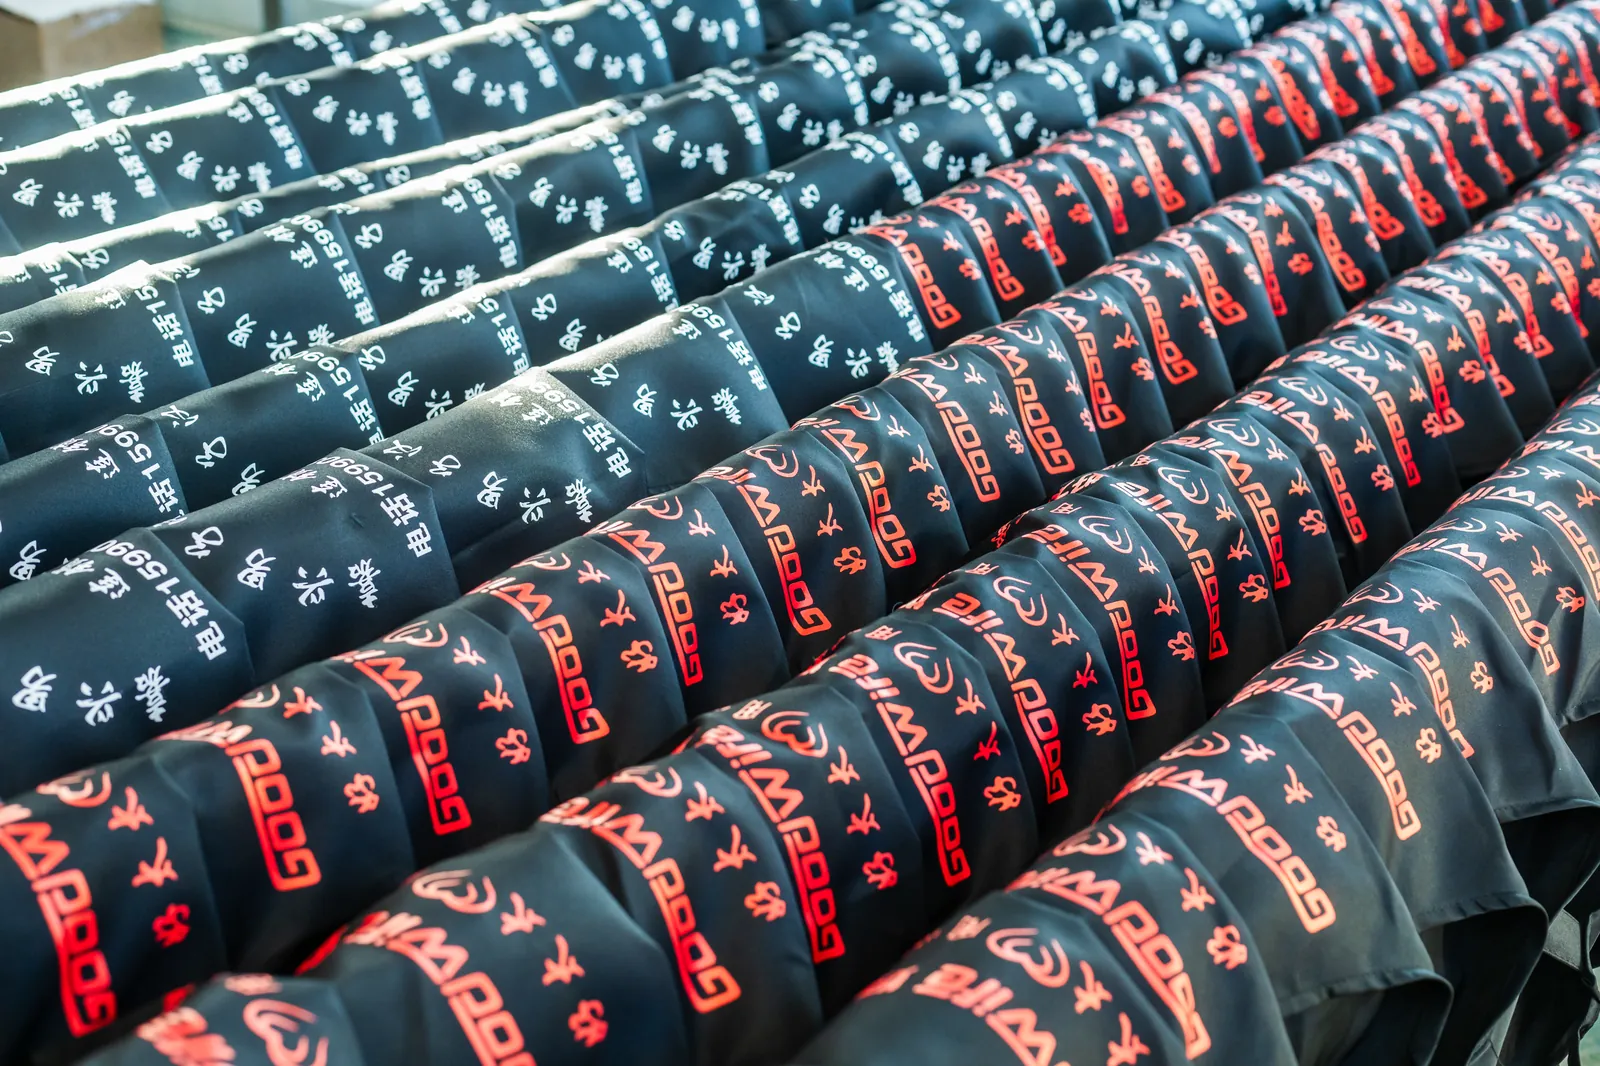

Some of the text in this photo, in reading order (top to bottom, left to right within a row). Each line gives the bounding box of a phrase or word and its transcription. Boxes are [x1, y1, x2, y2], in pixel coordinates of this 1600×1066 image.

[1137, 547, 1196, 661] 好太太
[1214, 493, 1269, 603] 好太太
[1051, 612, 1118, 736] 好太太
[955, 678, 1022, 811] 好太太
